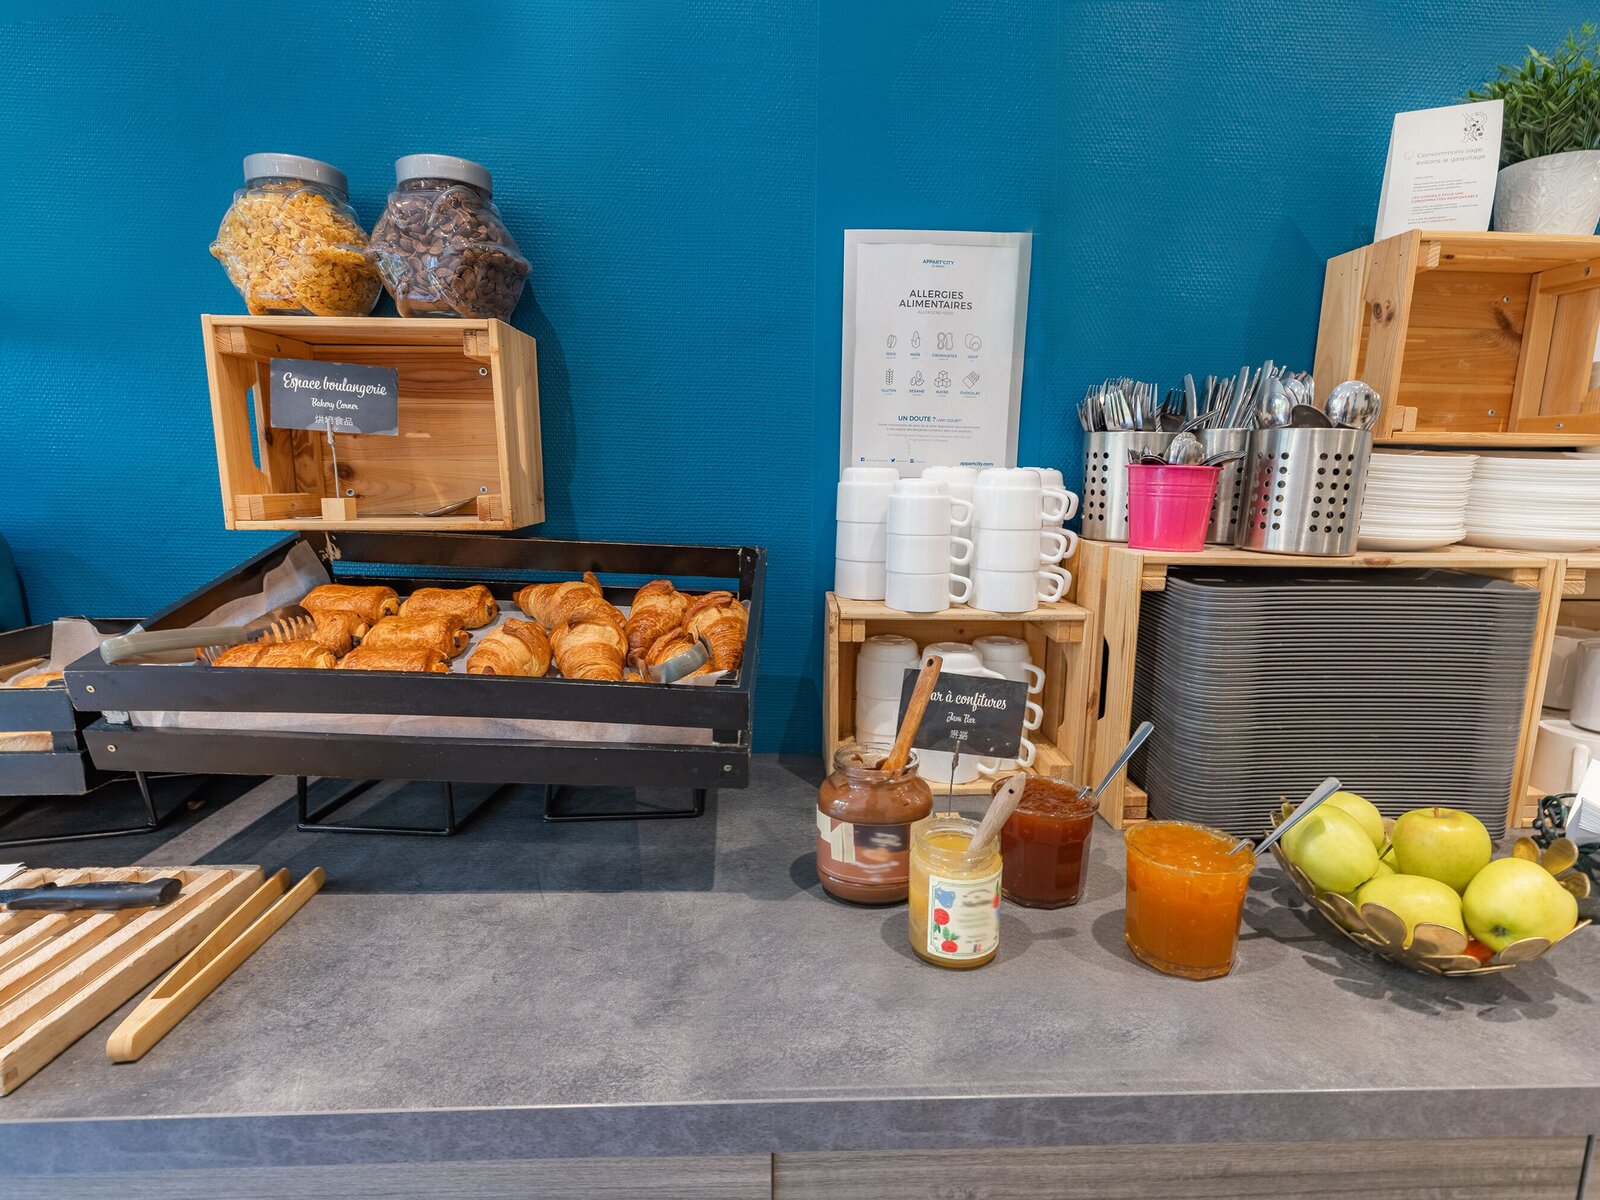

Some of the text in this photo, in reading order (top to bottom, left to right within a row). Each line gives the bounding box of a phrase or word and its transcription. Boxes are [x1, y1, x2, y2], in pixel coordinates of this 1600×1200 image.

[909, 289, 964, 300] ALLERGIES
[898, 300, 973, 310] ALIMENTAIRES
[283, 372, 387, 398] Espace boulangerie
[311, 397, 359, 411] Bakery Corner
[945, 690, 954, 703] à
[955, 692, 1007, 712] confitures
